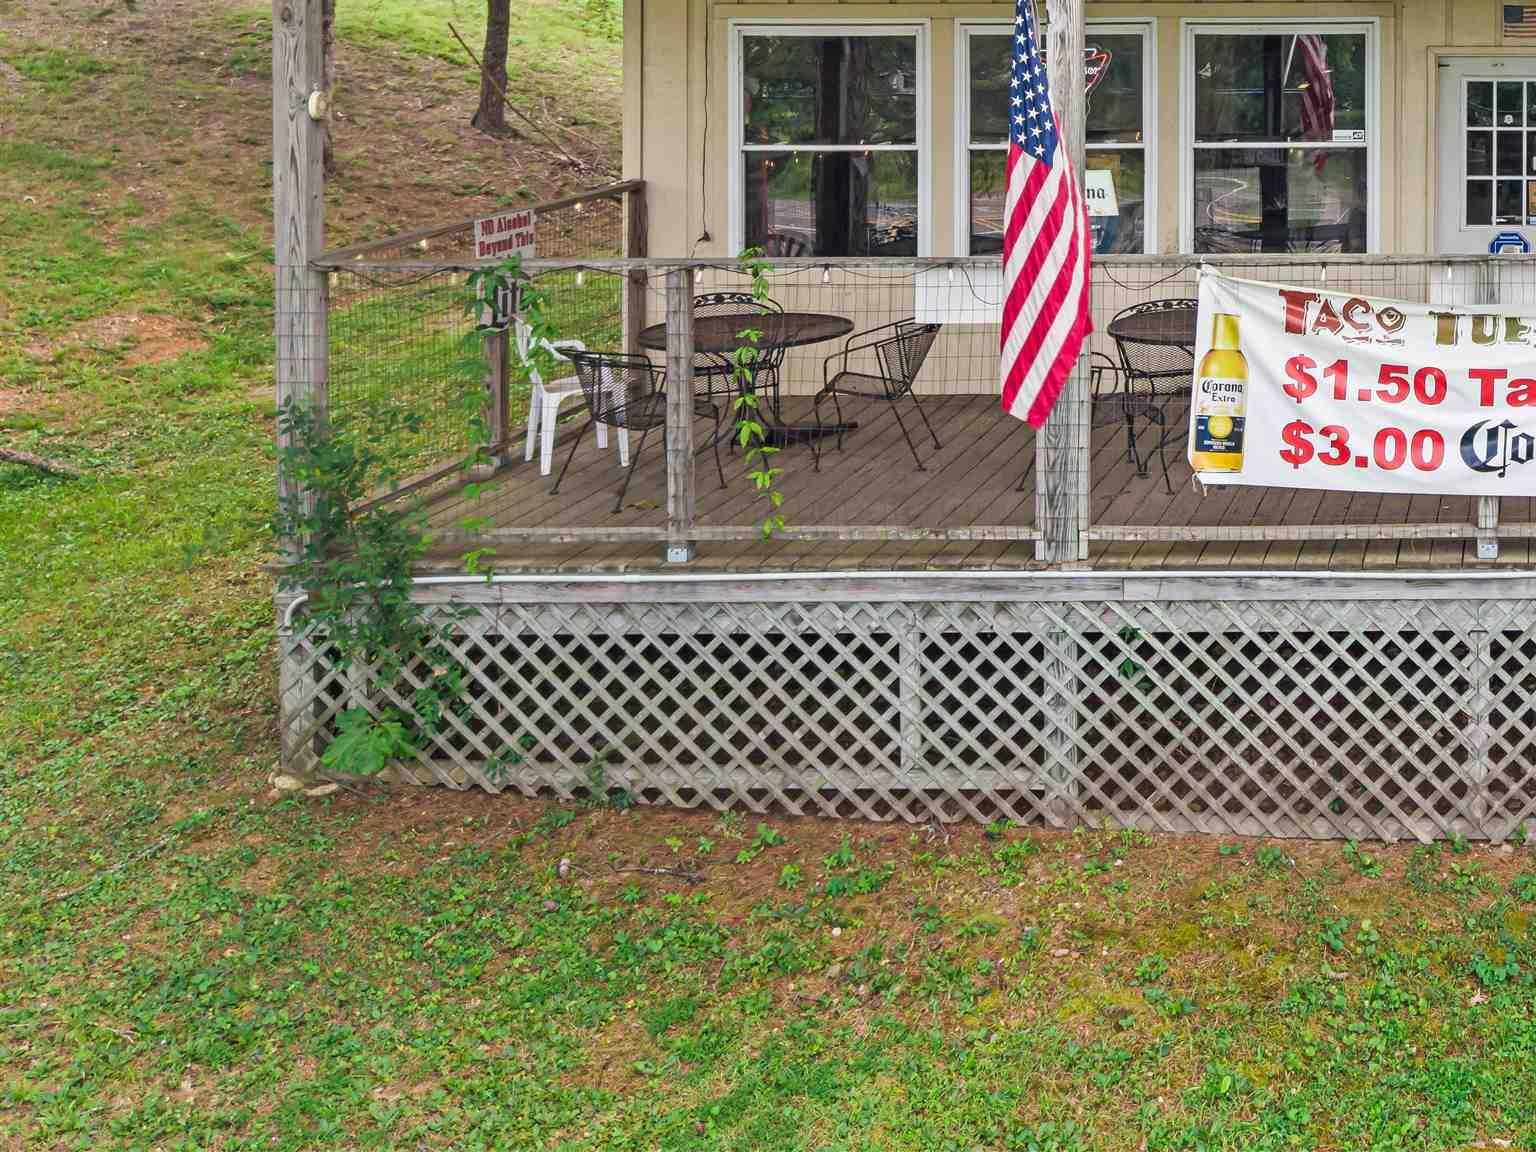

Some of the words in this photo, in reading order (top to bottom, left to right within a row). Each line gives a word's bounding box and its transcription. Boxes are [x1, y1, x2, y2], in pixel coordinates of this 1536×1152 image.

[1279, 289, 1407, 345] TACO
[1202, 379, 1244, 393] Corona
[1211, 392, 1236, 402] Extra
[1282, 354, 1448, 406] $1.50
[1279, 419, 1445, 472] $3.00
